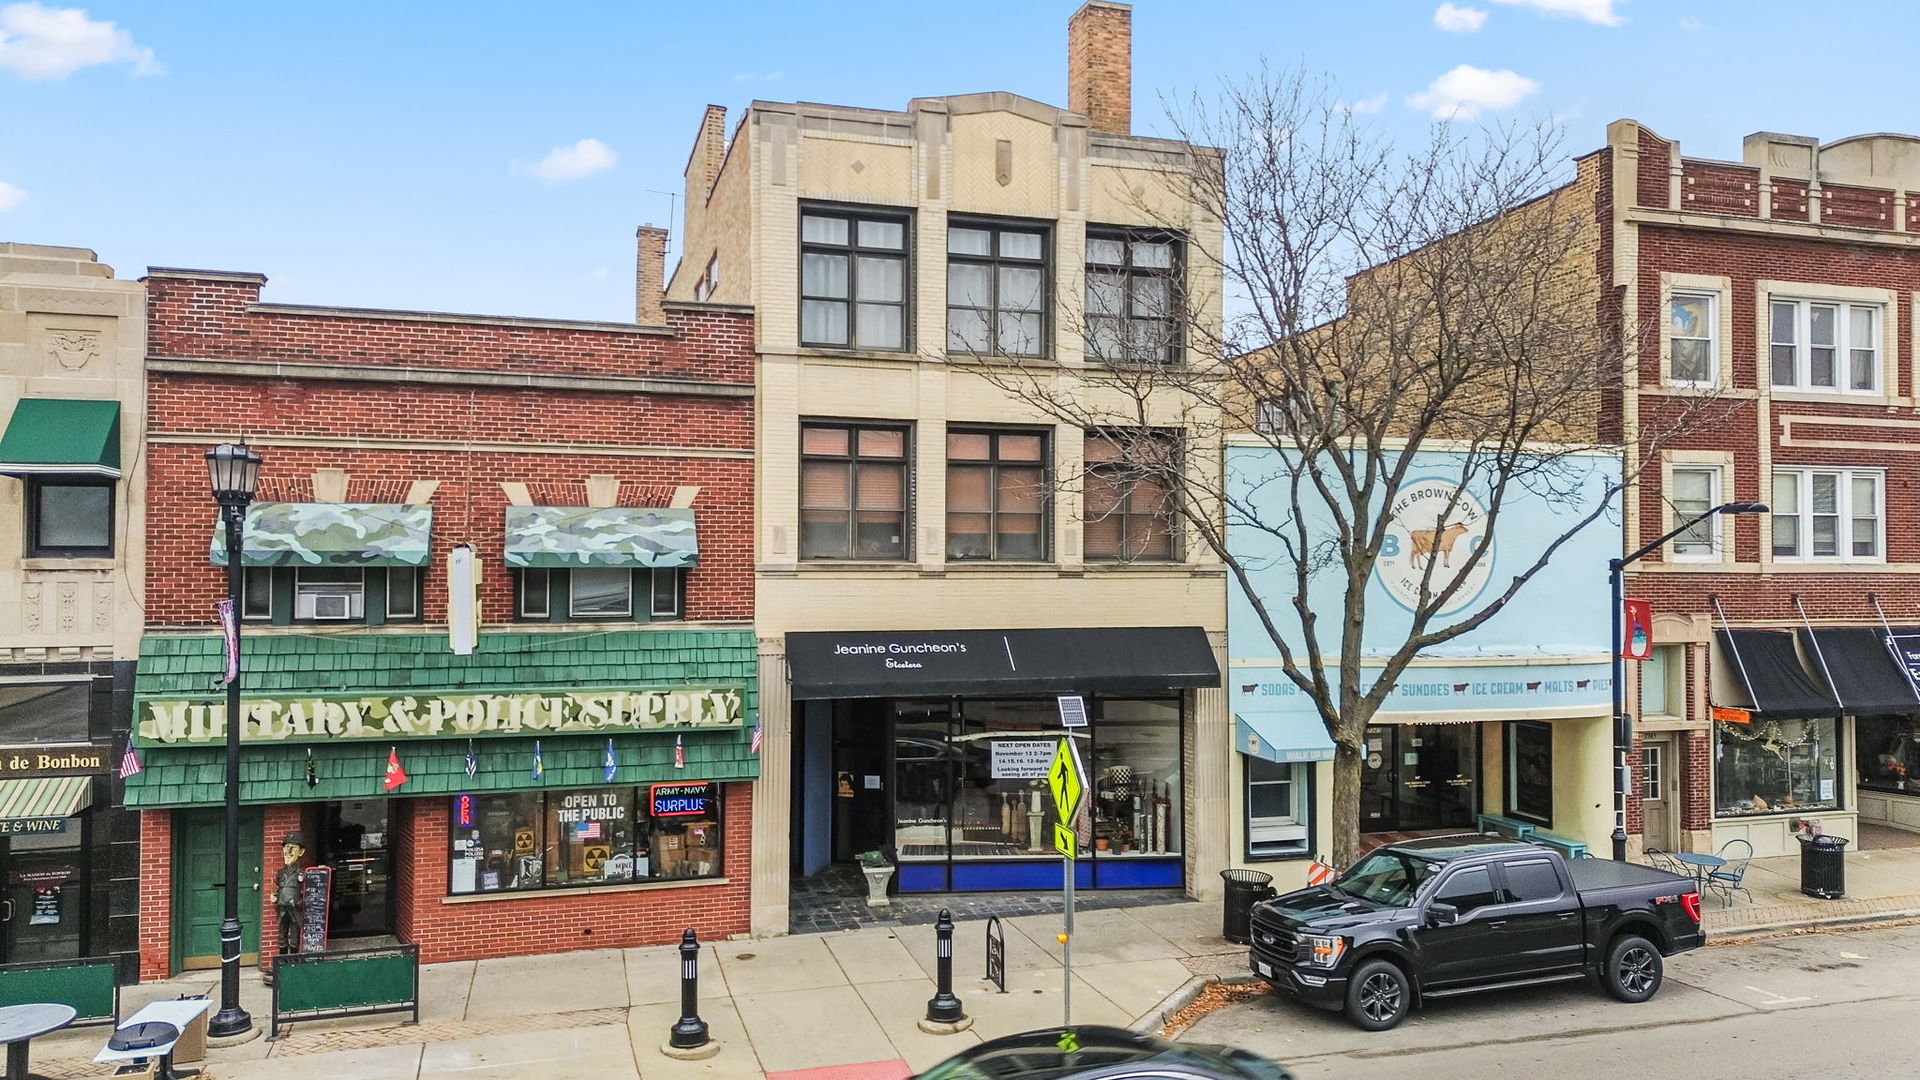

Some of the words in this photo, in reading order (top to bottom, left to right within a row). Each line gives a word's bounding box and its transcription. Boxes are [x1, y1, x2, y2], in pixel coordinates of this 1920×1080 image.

[1391, 498, 1409, 519] THE
[1410, 488, 1453, 502] BROWN
[1380, 534, 1400, 557] B
[1400, 577, 1413, 592] ICE
[834, 644, 886, 655] Jeanine
[888, 642, 967, 654] Guncheon's
[885, 658, 922, 669] Etcetera
[1261, 683, 1295, 696] SODAS
[1402, 683, 1450, 697] SUNDAES
[1472, 682, 1488, 695] ICE
[1490, 681, 1524, 695] CREAM
[1544, 680, 1574, 693] MALTS
[1593, 679, 1609, 691] PIES
[149, 699, 371, 738] MILITARY
[383, 696, 417, 733] &
[424, 695, 573, 734] POLICE
[579, 689, 741, 730] SUPPLY
[9, 756, 30, 770] de
[37, 753, 100, 769] Bonbon
[1286, 751, 1308, 760] WALK
[1310, 751, 1320, 760] UP
[655, 786, 706, 796] ARMY-NAVY
[564, 795, 597, 808] OPEN
[602, 793, 617, 806] TO
[655, 798, 704, 812] SURPLUS
[461, 796, 470, 825] OPEN
[558, 809, 580, 822] THE
[582, 806, 625, 820] PUBLIC
[13, 821, 23, 832] &
[26, 820, 60, 831] WINE
[615, 862, 633, 871] MINE
